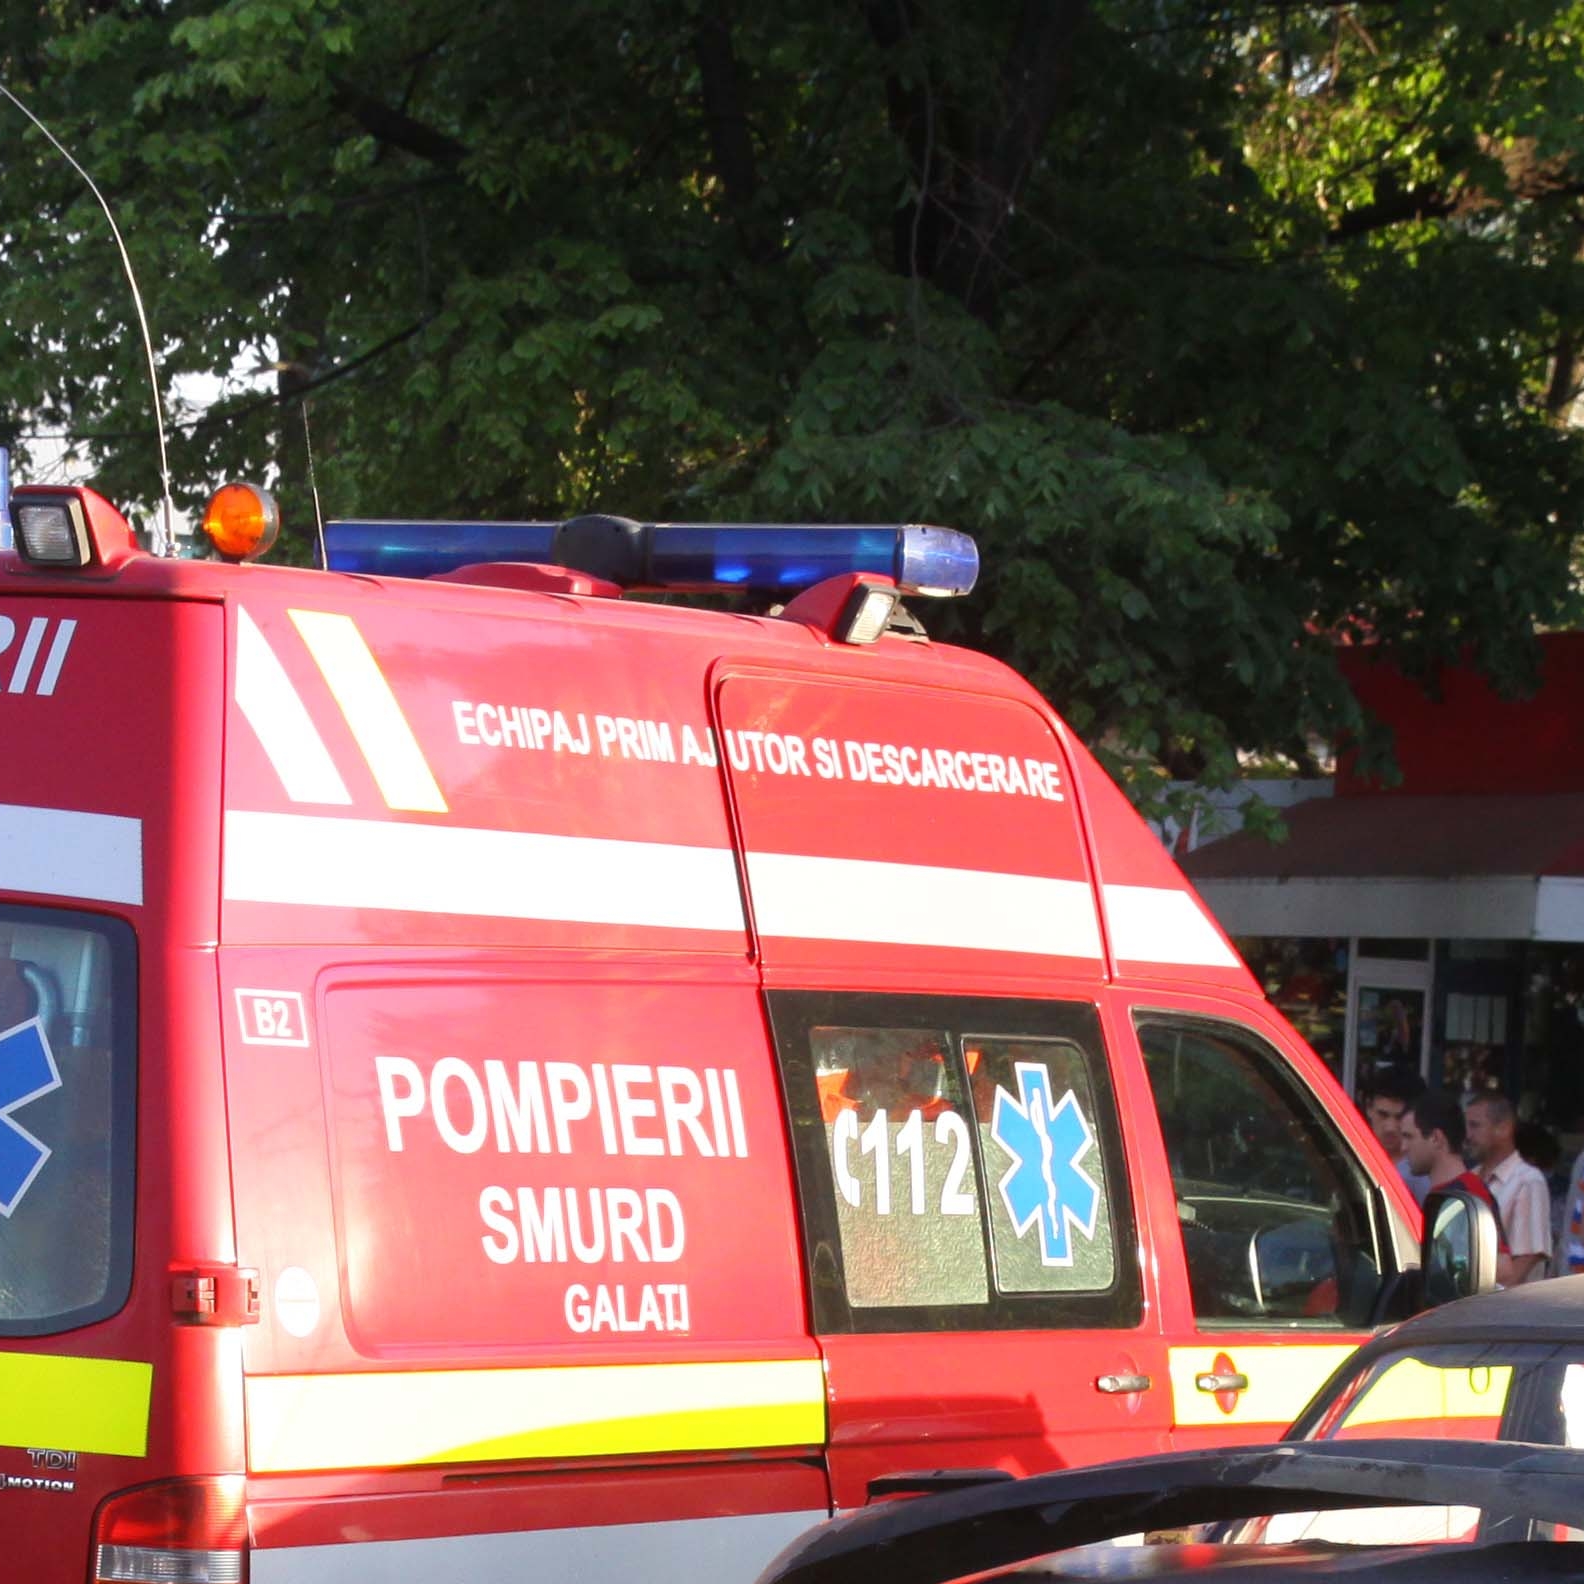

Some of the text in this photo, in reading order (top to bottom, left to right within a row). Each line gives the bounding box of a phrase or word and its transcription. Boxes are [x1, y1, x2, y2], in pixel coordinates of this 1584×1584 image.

[453, 701, 1064, 802] ECHIPAJ PRIM AJUTOR SI DESCARCERARE
[254, 999, 292, 1037] B2
[375, 1056, 748, 1159] POMPIERII
[480, 1186, 685, 1265] SMURD
[27, 1448, 76, 1471] TDI
